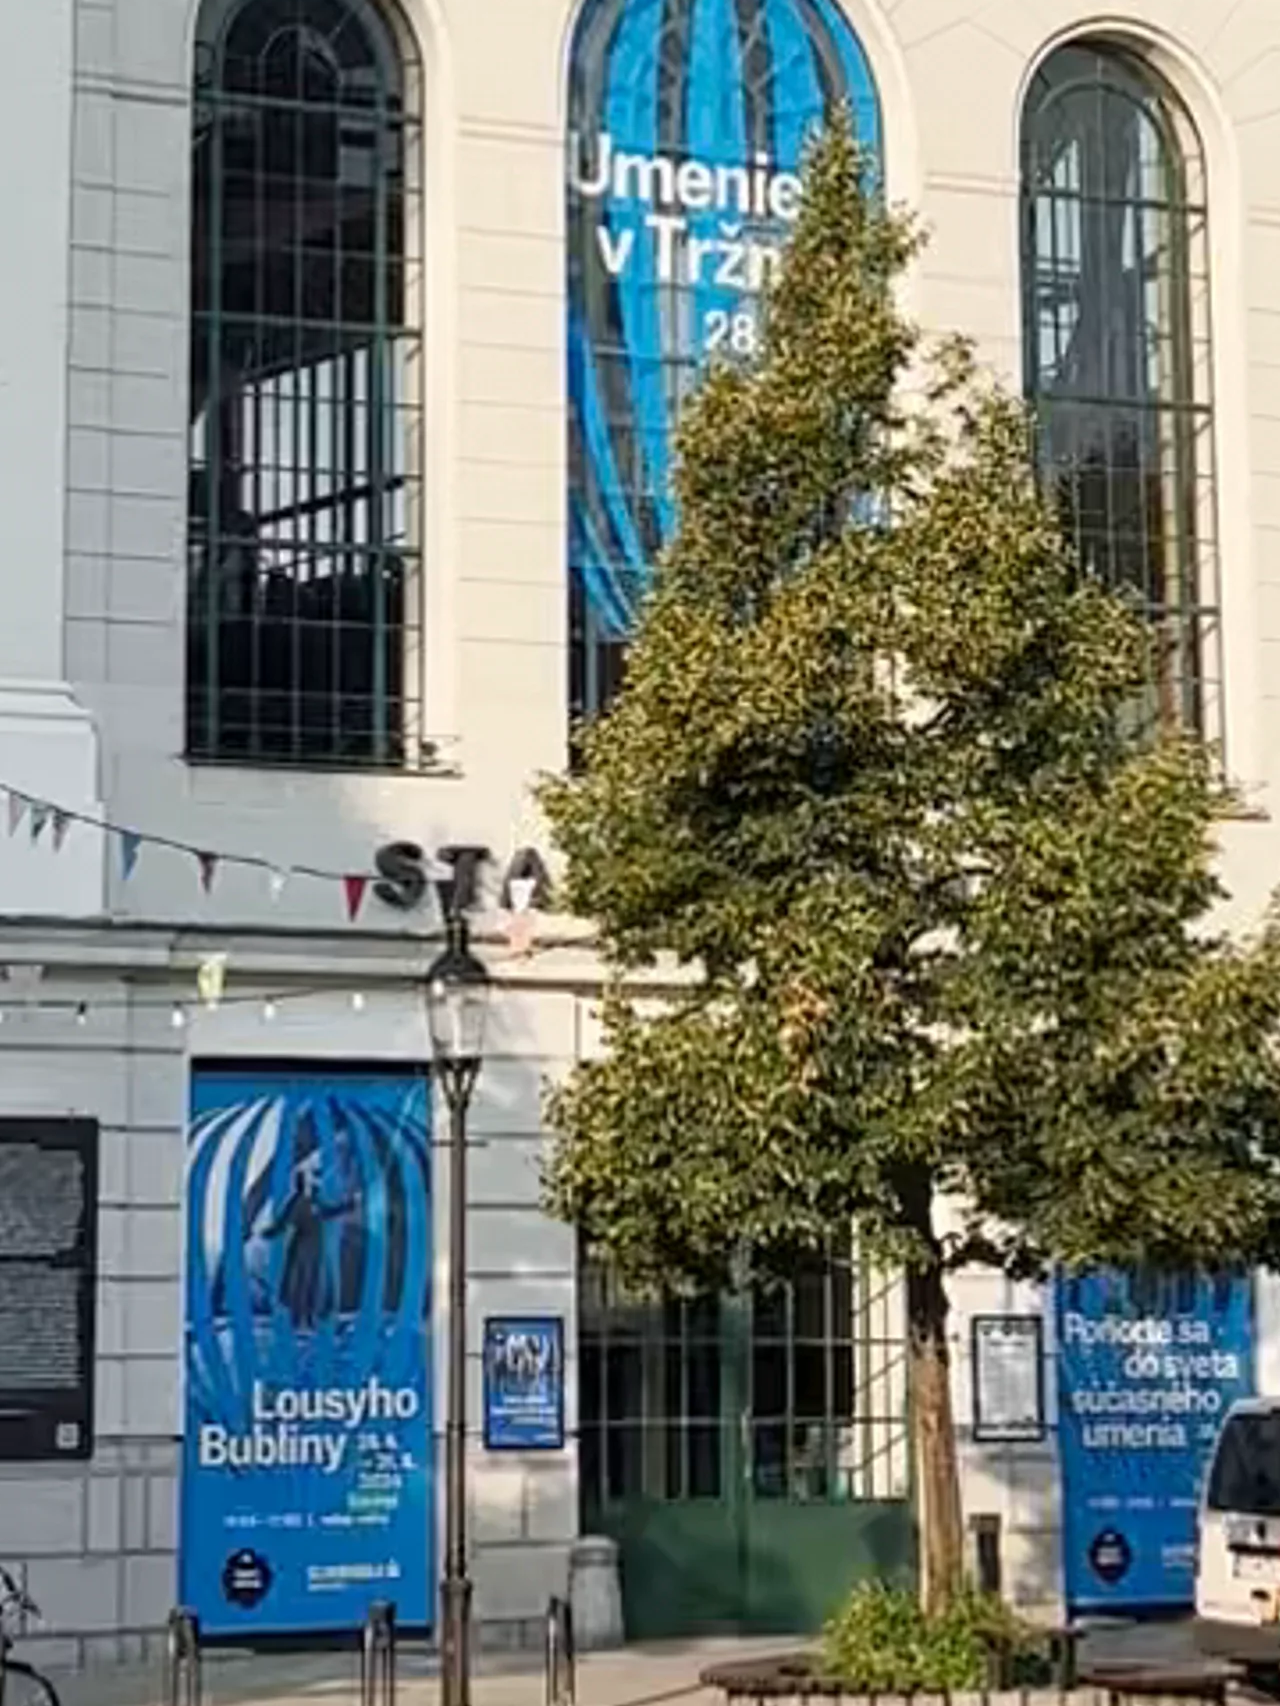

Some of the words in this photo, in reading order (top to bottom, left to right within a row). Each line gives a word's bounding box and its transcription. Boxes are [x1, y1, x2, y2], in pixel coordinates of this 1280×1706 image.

[570, 131, 805, 219] Umenie
[596, 224, 635, 275] v
[644, 213, 782, 288] Tržn
[372, 841, 554, 913] STA
[1178, 1319, 1211, 1344] sa
[1124, 1348, 1159, 1378] do
[1164, 1348, 1240, 1379] sveta
[252, 1374, 420, 1428] Lousyho
[199, 1422, 348, 1476] Bubliny
[1082, 1415, 1189, 1449] umenia
